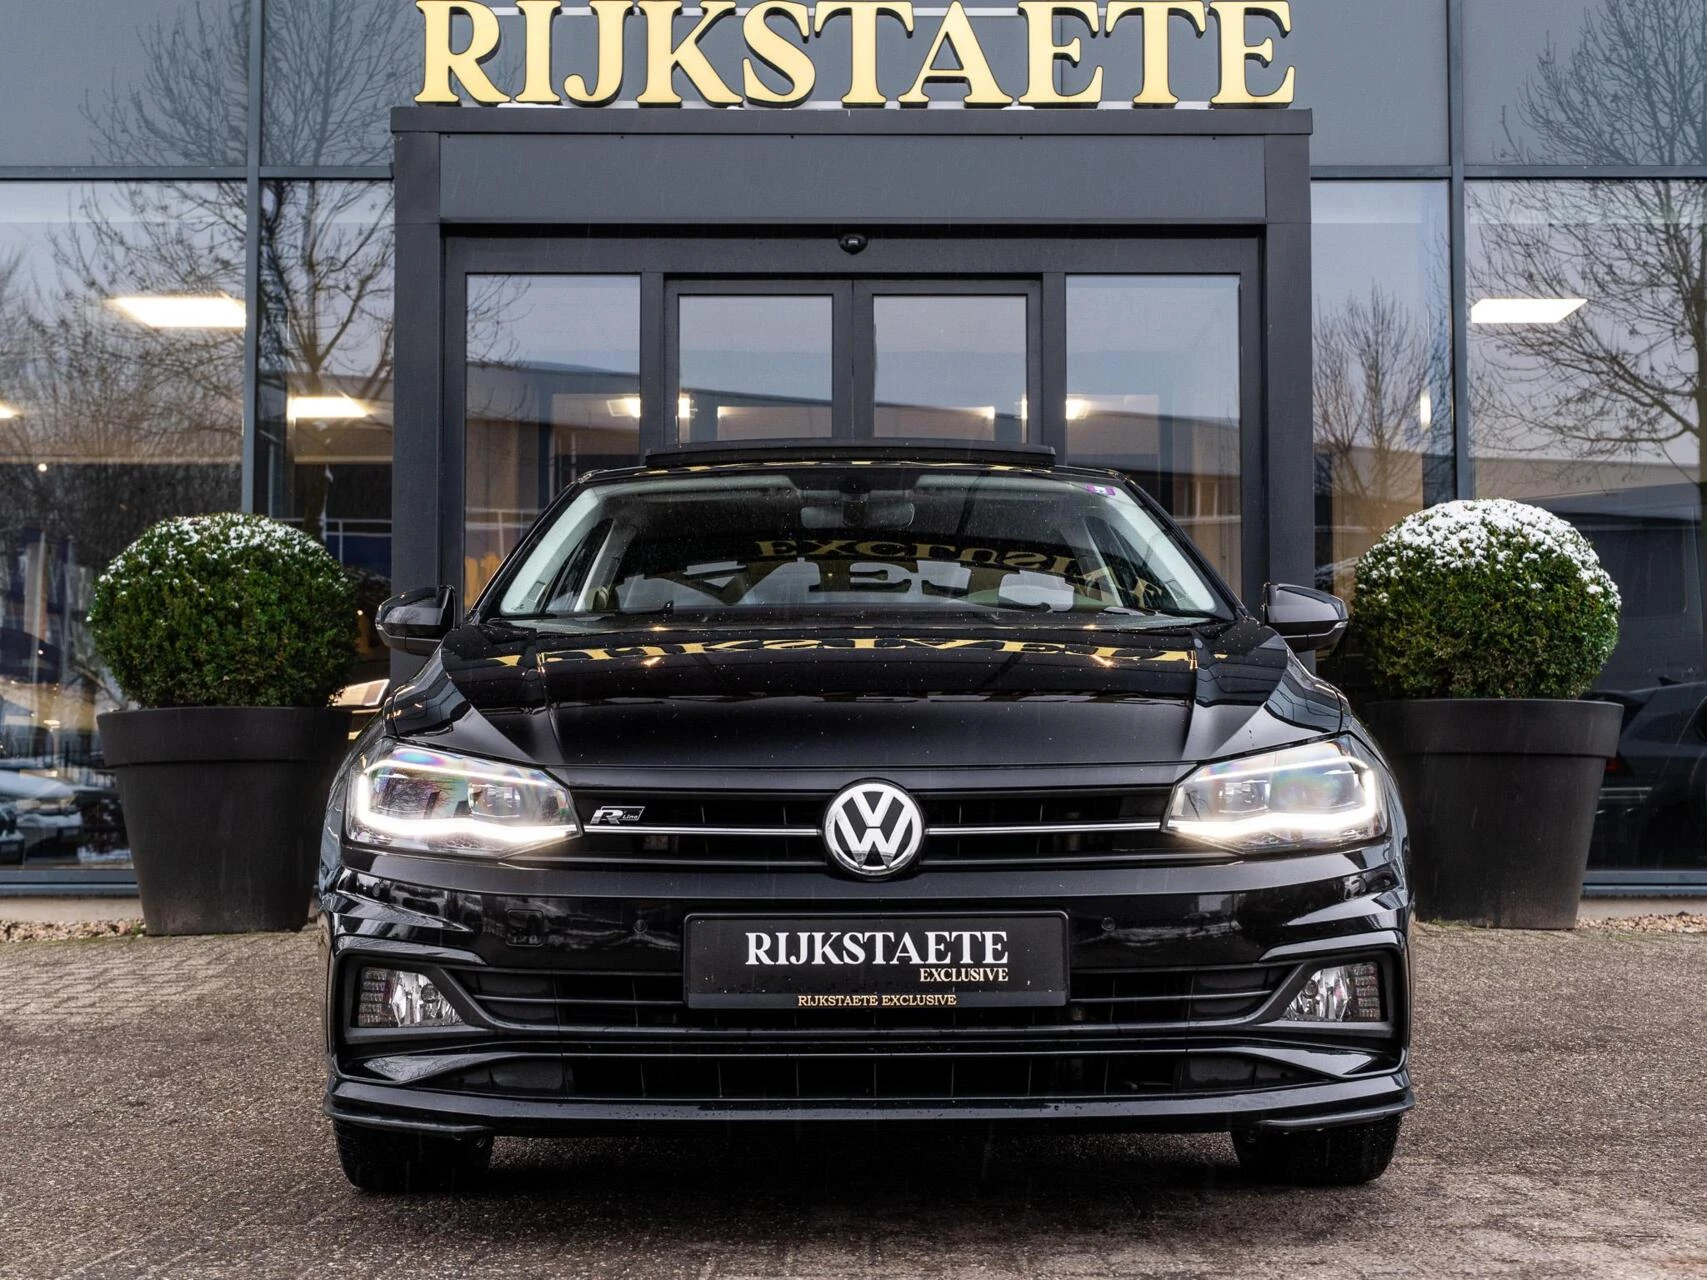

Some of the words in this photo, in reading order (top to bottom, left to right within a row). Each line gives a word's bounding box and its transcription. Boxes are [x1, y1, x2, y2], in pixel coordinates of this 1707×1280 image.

[416, 0, 1295, 107] RIJKSTAETE
[745, 931, 1009, 965] RIJKSTAETE
[919, 968, 1009, 982] EXCLUSIVE
[798, 995, 879, 1007] RIJKSTAETE
[881, 995, 957, 1006] EXCLUSIVE
